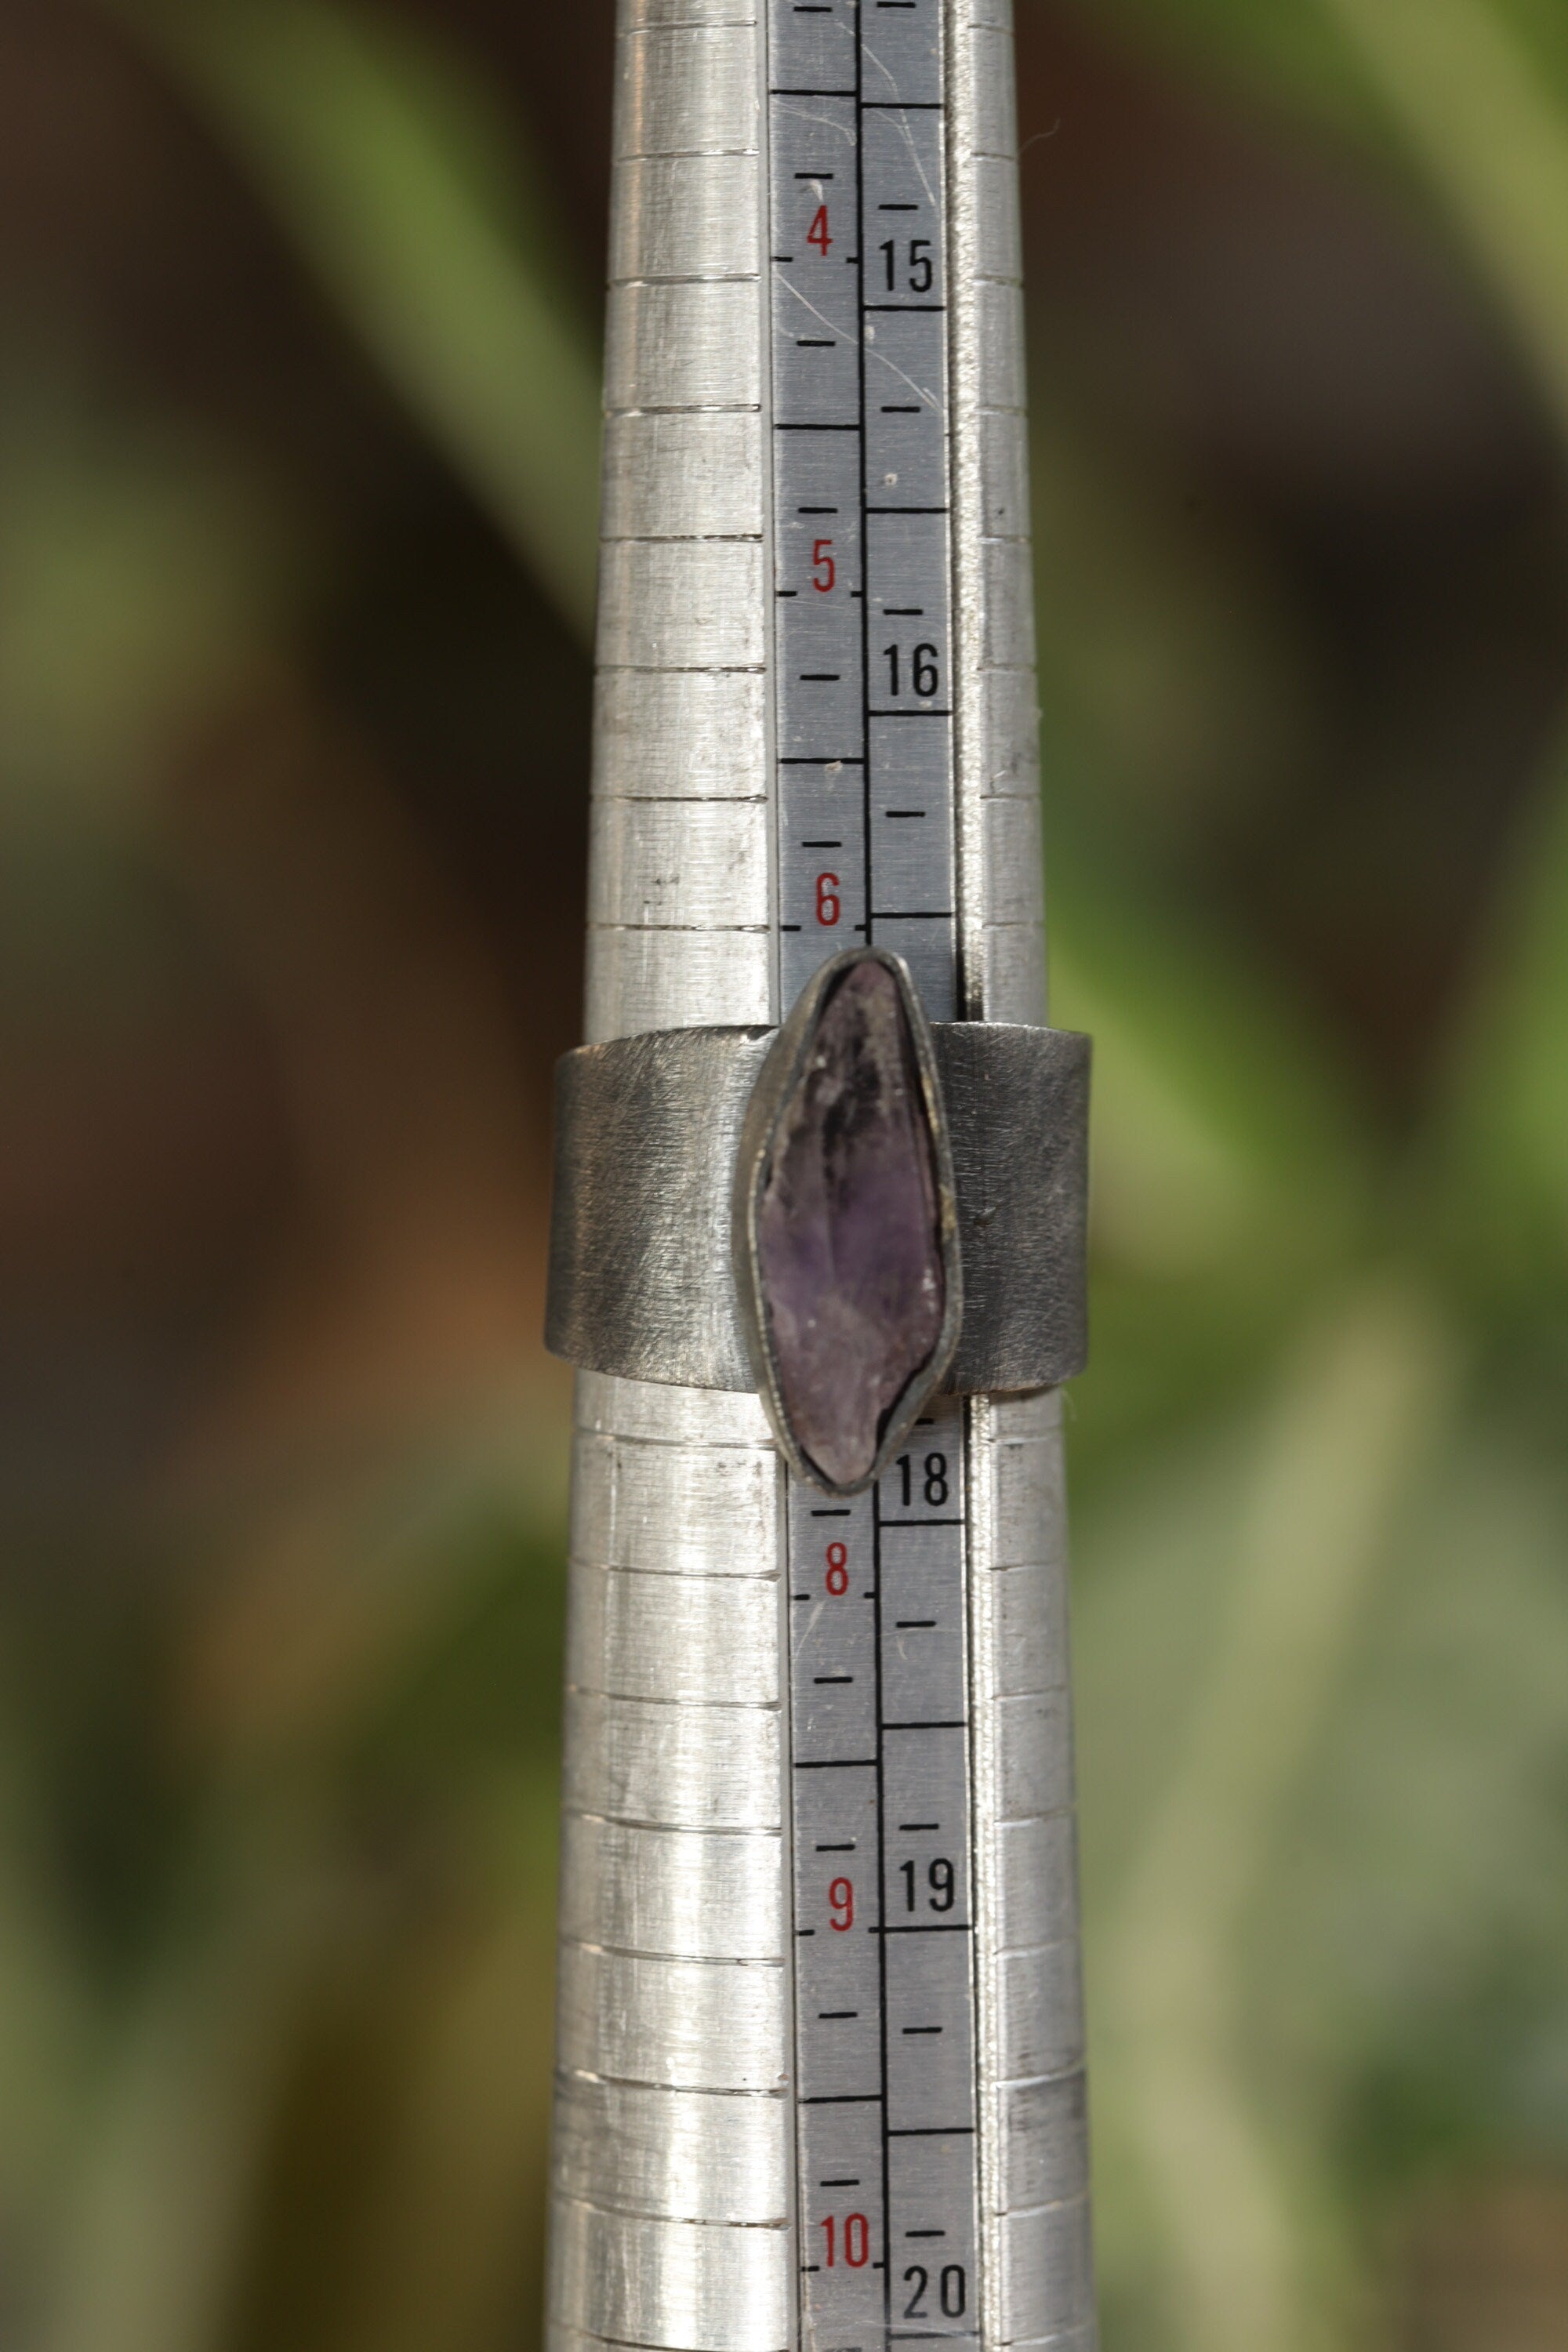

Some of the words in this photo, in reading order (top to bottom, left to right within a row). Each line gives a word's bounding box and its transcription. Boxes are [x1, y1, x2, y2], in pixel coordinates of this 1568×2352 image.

[806, 204, 833, 256] 4
[878, 239, 932, 293] 15
[812, 539, 835, 592] 5
[883, 643, 939, 698] 16
[815, 872, 840, 926] 6
[895, 1452, 949, 1506] 18
[826, 1541, 849, 1596] 8
[829, 1877, 855, 1932] 9
[899, 1857, 955, 1911] 19
[820, 2212, 869, 2267] 10
[903, 2264, 966, 2319] 20
